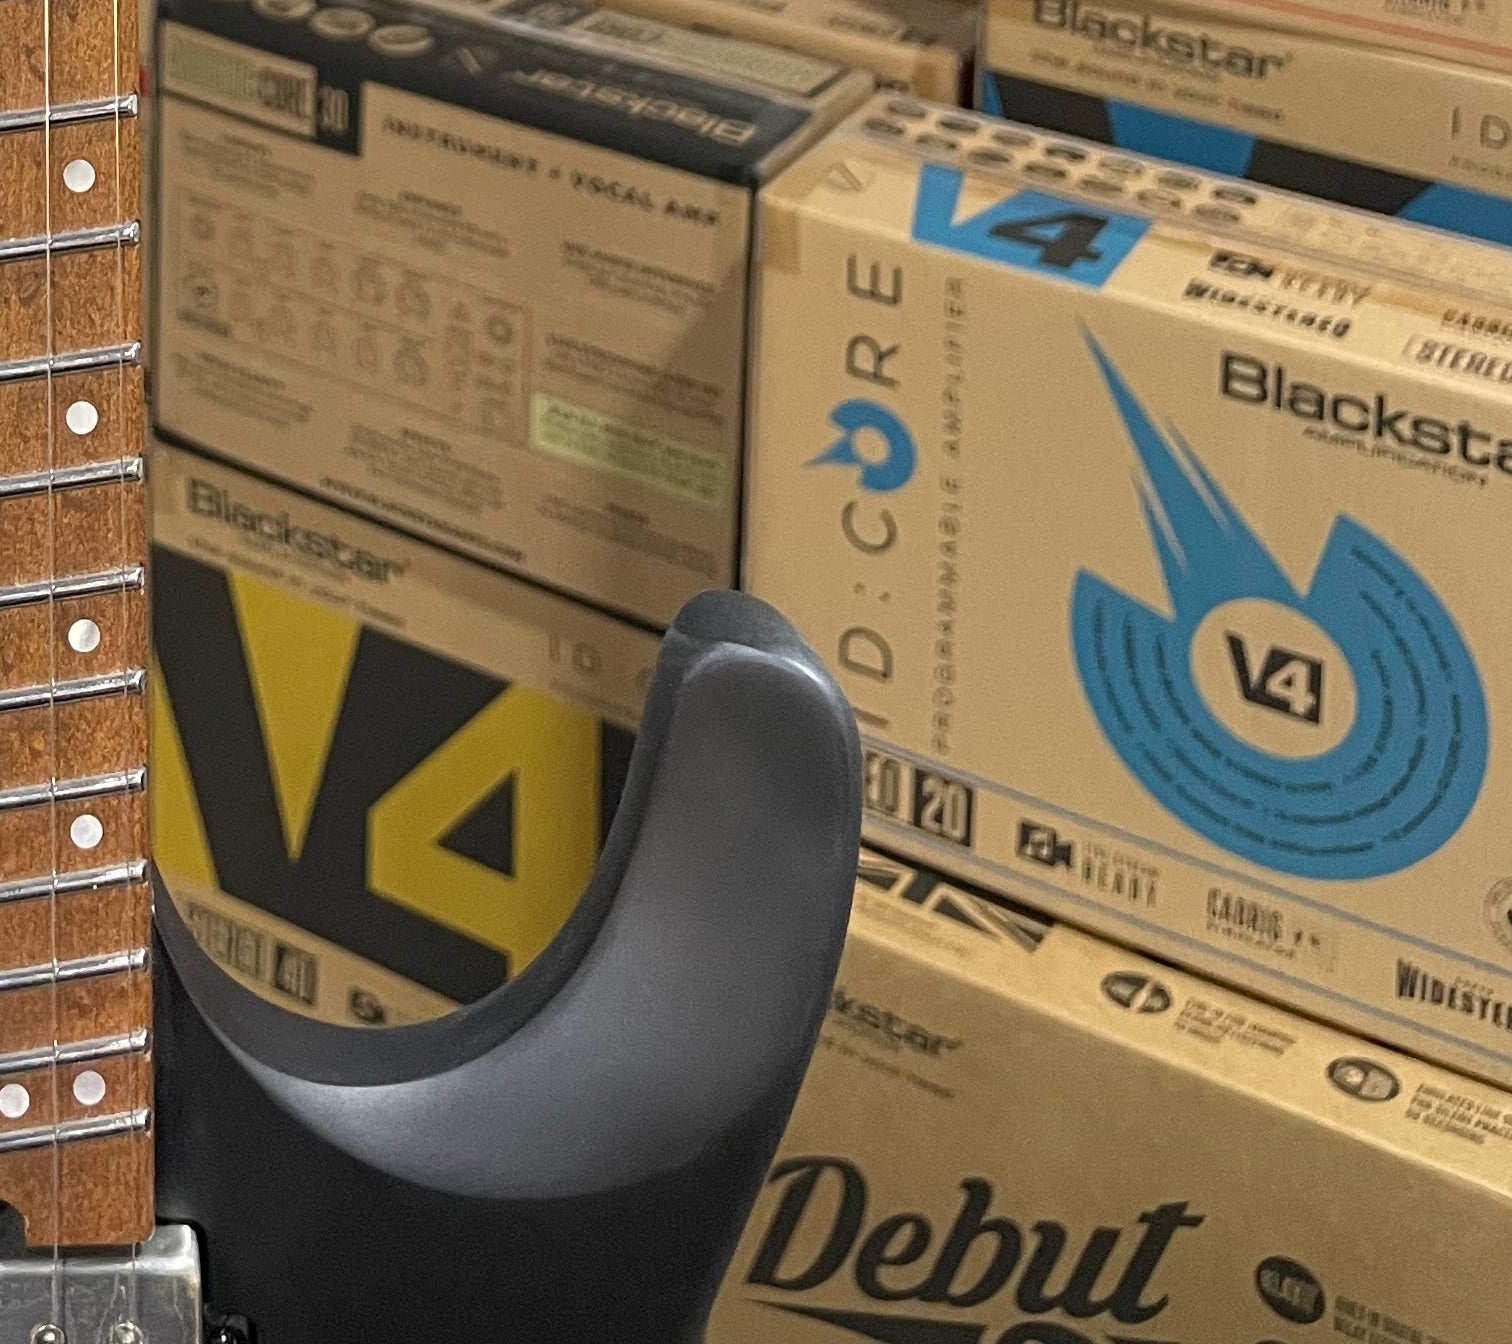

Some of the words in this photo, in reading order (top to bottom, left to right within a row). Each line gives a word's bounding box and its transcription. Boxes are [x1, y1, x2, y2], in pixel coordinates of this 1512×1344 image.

[912, 160, 1153, 291] V4
[190, 479, 396, 584] Blackstar
[1221, 628, 1325, 725] V4
[920, 773, 970, 843] 20
[744, 1154, 1206, 1324] Debut
